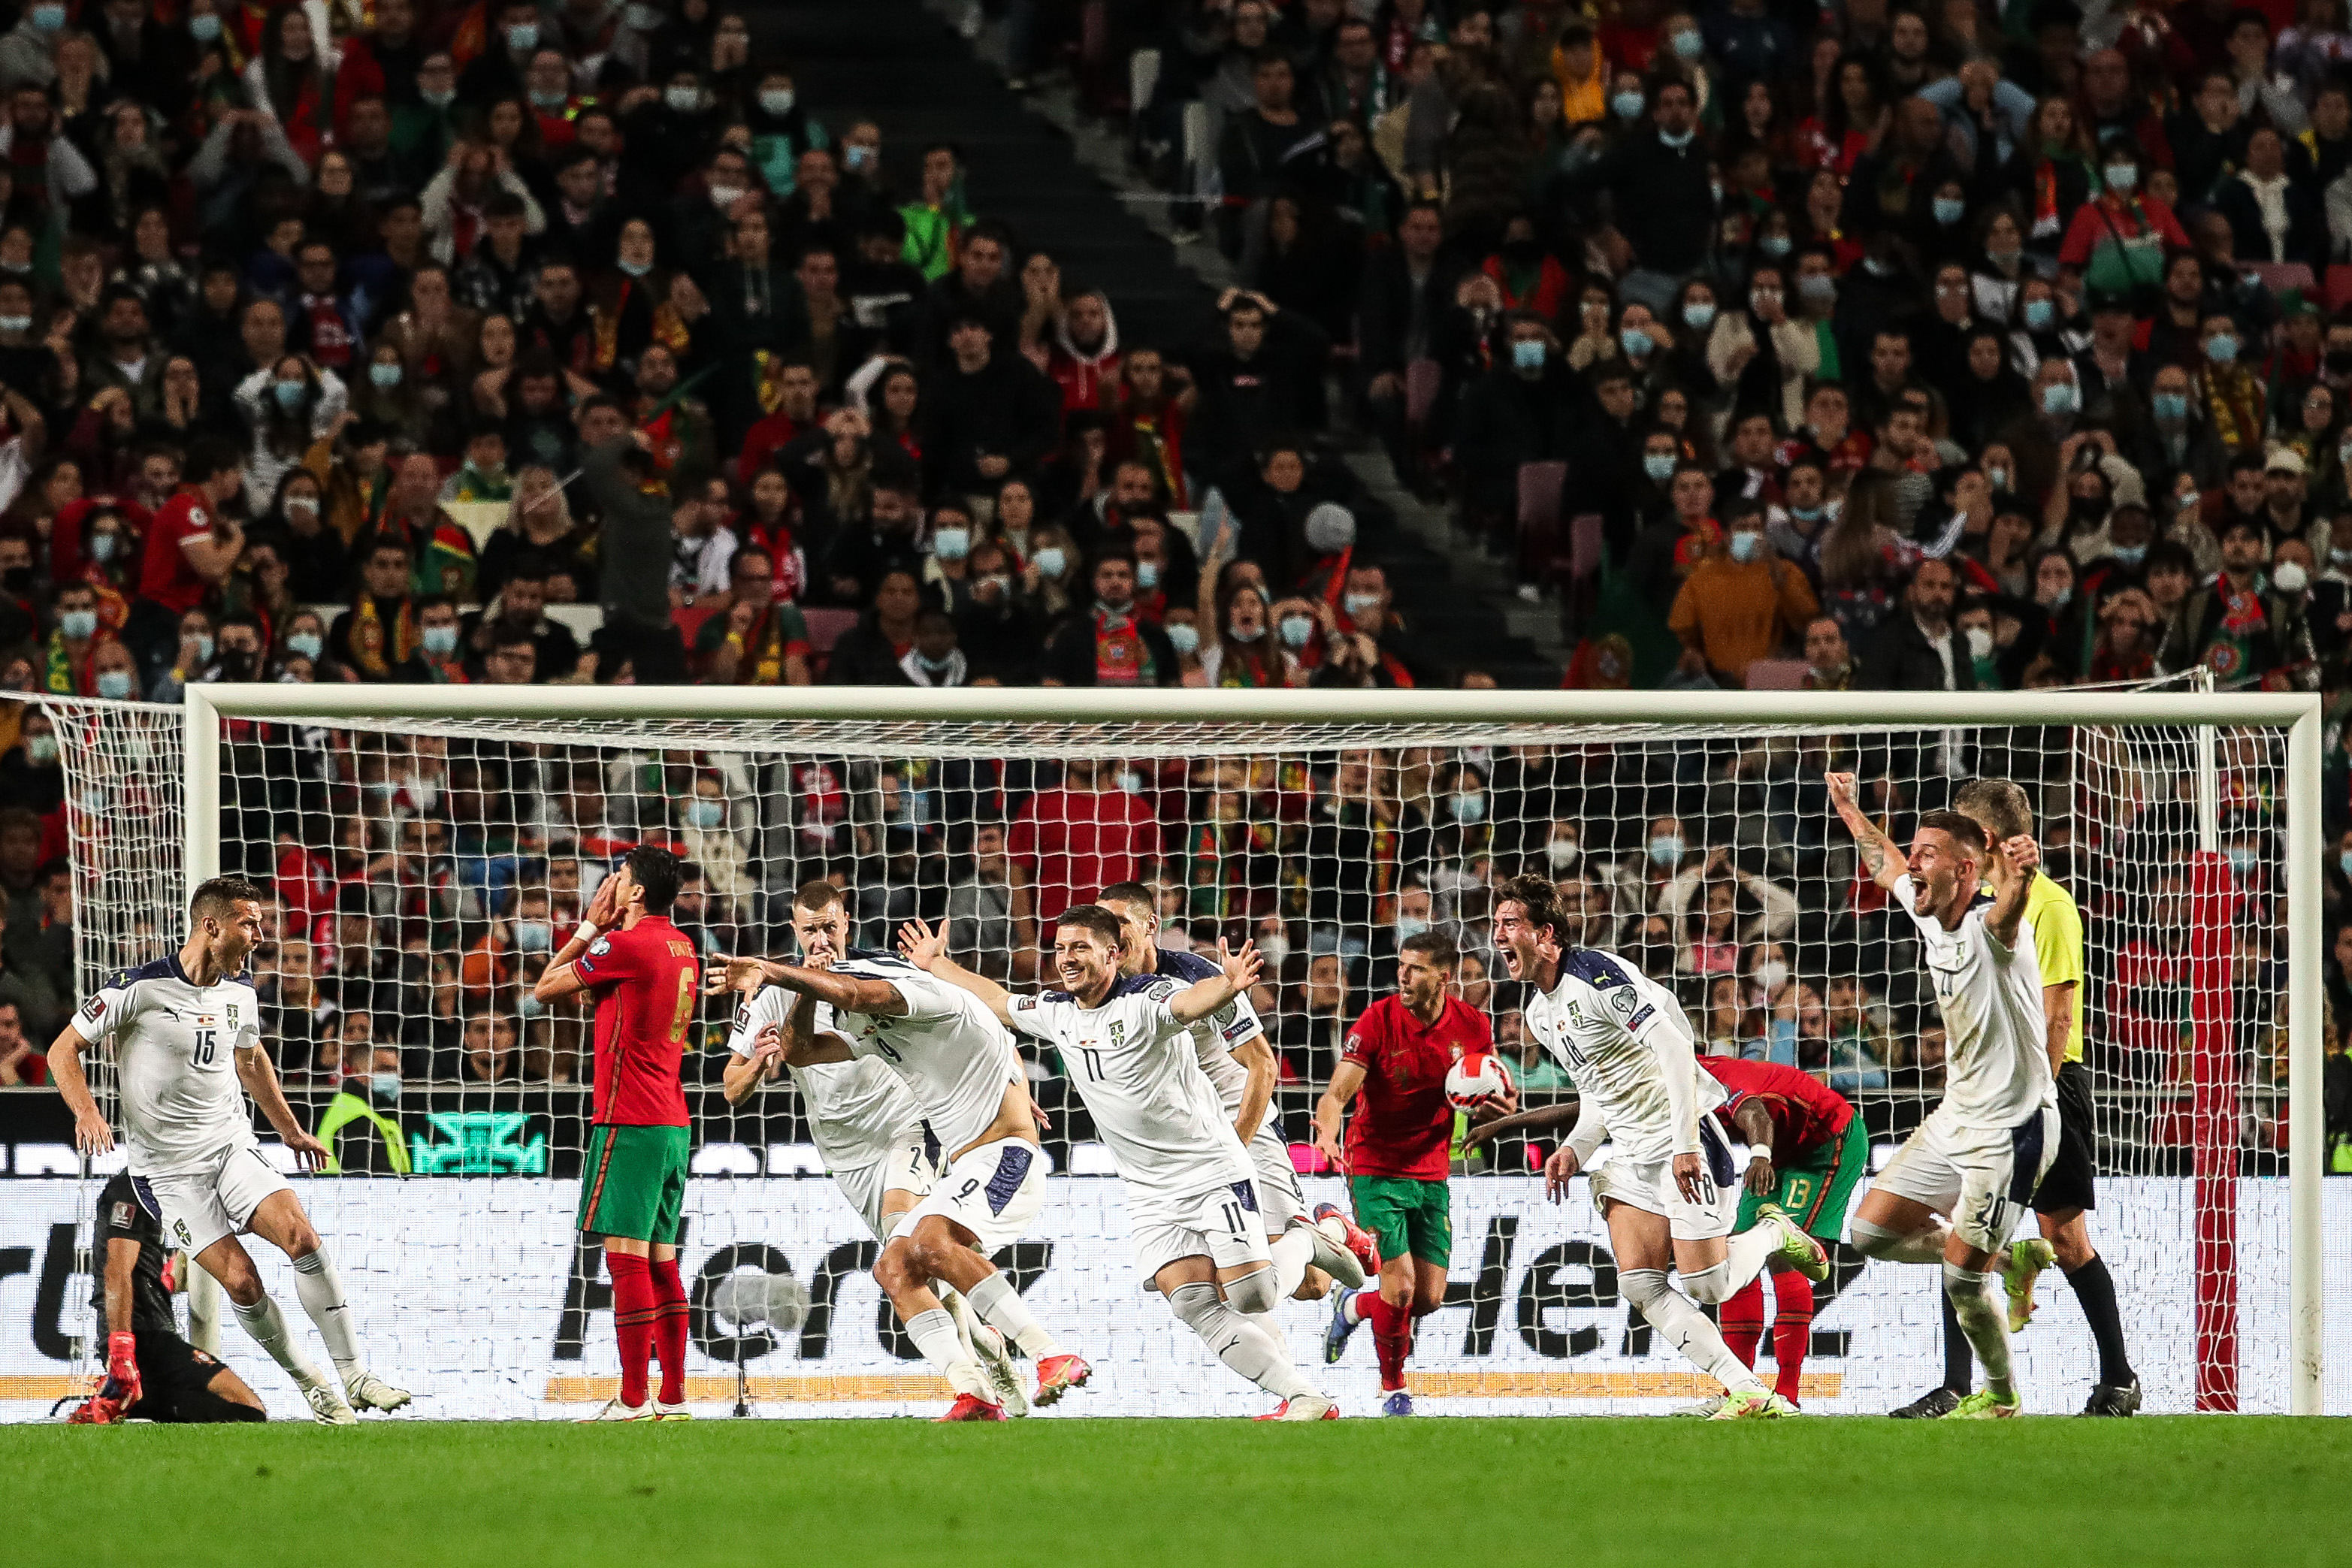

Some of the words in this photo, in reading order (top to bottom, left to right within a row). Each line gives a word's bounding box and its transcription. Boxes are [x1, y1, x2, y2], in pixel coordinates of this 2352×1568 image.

[670, 967, 694, 1044] 6
[193, 1030, 216, 1065] 15
[876, 1037, 902, 1062] 9
[1561, 1035, 1587, 1069] 18
[1082, 1048, 1106, 1083] 11
[910, 1147, 921, 1172] 2
[957, 1178, 980, 1199] 9
[1785, 1178, 1812, 1209] 13
[1221, 1201, 1247, 1234] 11
[1976, 1192, 2006, 1229] 20
